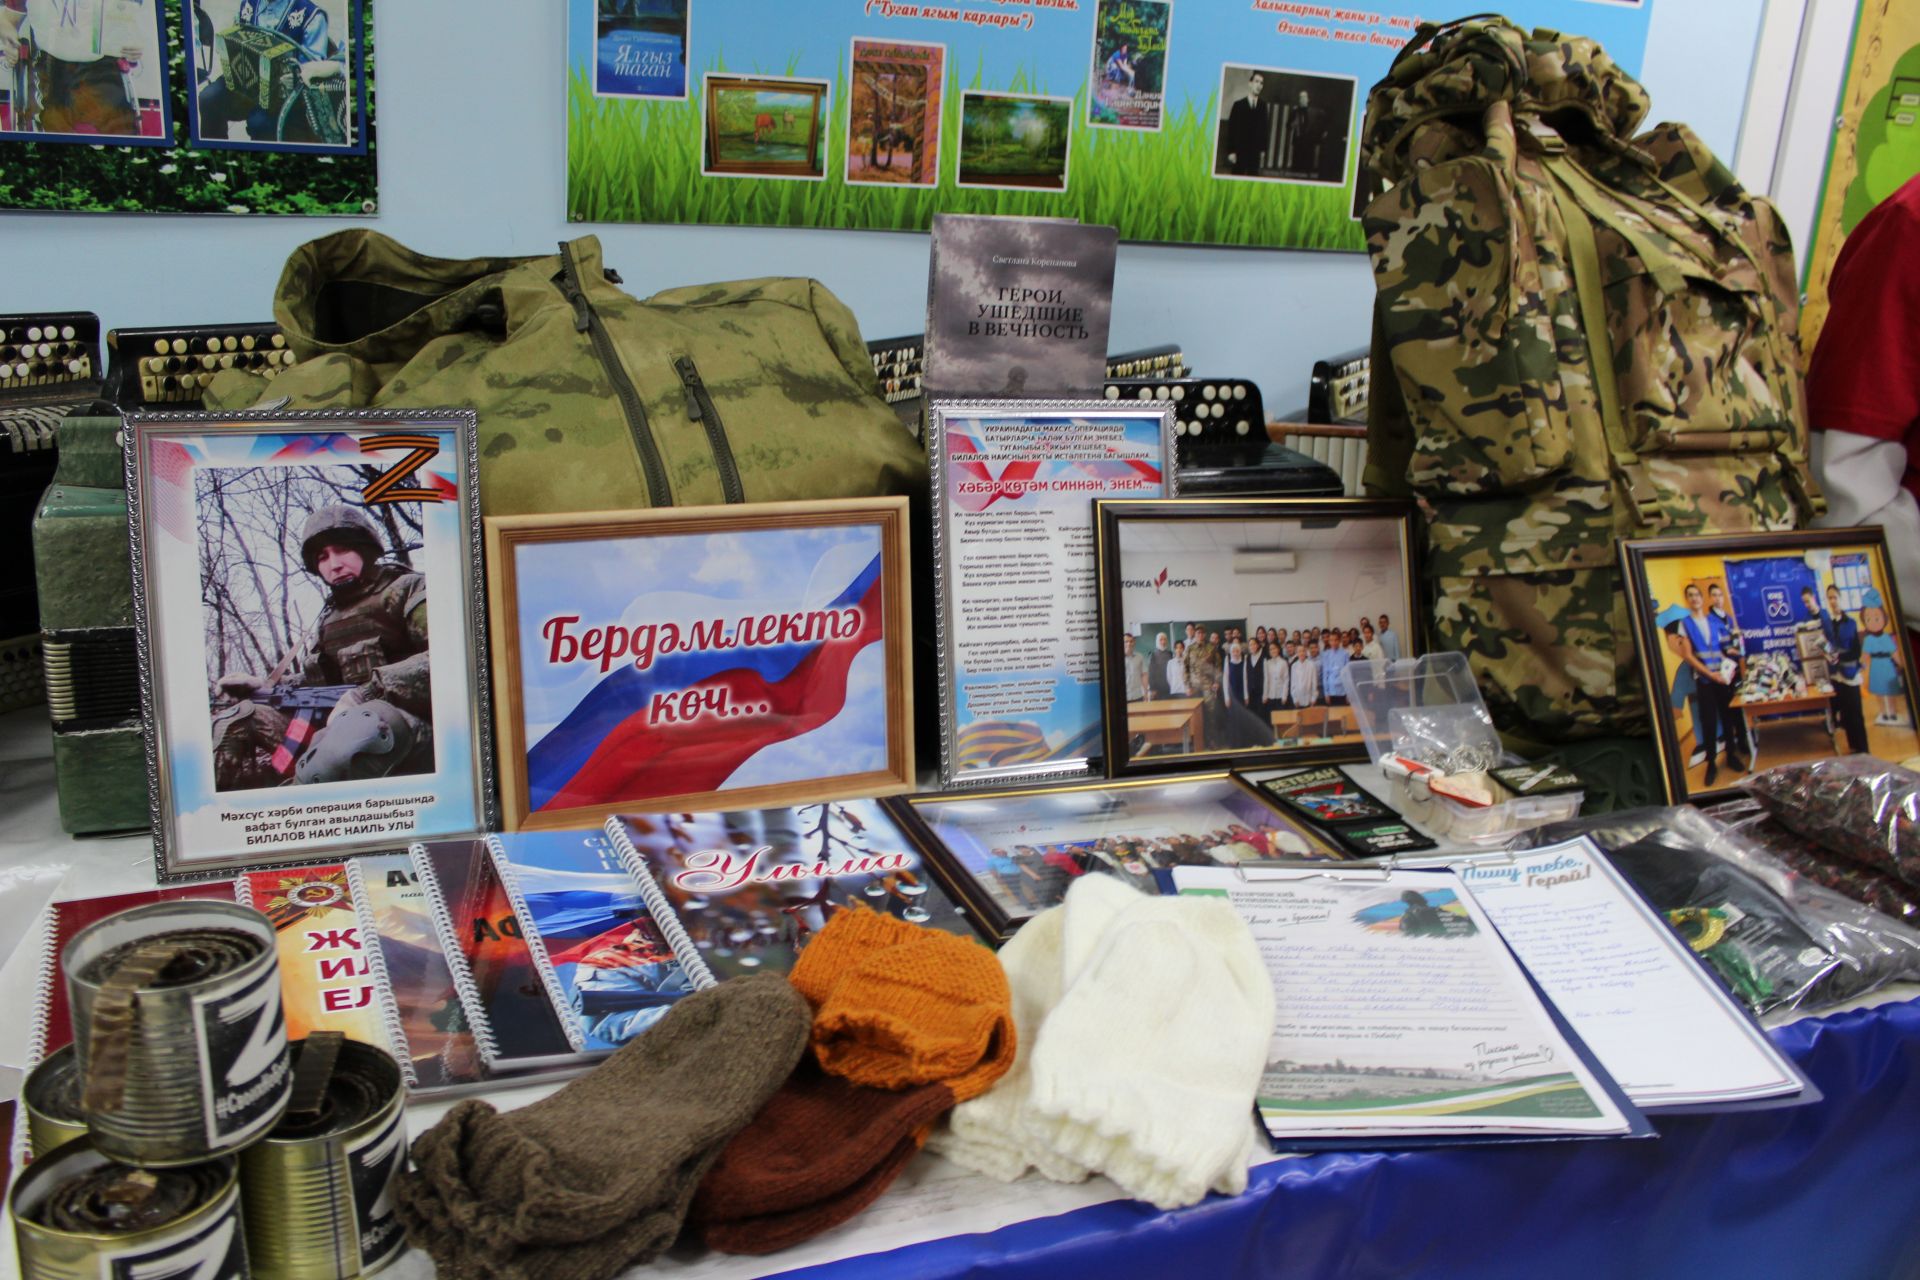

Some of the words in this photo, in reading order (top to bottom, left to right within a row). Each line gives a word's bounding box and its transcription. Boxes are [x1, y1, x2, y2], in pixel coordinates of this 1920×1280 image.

[921, 8, 959, 20] ягым
[614, 44, 673, 65] Ялгыз
[614, 63, 672, 78] таган
[992, 255, 1029, 266] Светлана
[998, 287, 1066, 305] ГЕРОИ,
[977, 304, 1084, 322] УШЕДШИЕ
[968, 321, 980, 336] В
[984, 322, 1089, 340] ВЕЧНОСТЬ
[1043, 425, 1072, 433] МАХСУС
[985, 434, 1035, 442] БАТЫРЛАРЧА
[1065, 434, 1093, 442] БУЛГАН
[951, 453, 989, 461] БИЛАЛОВ
[958, 481, 1001, 494] ХӘБӘР
[1004, 480, 1048, 493] КӨТӘМ
[1051, 479, 1106, 492] СИННӘН,
[1110, 479, 1153, 490] ЭНЕМ...
[1168, 579, 1198, 587] РОСТА
[543, 607, 862, 673] Бердәмлектә
[649, 687, 769, 724] көч...
[267, 807, 303, 821] хәрби
[306, 802, 362, 814] операция
[365, 794, 435, 809] барышында
[245, 821, 281, 833] вафат
[284, 816, 326, 829] булган
[329, 809, 415, 825] авылдашыбыз
[246, 831, 305, 845] БИЛАЛОВ
[309, 827, 341, 839] НАИС
[344, 824, 385, 836] НАИЛЬ
[388, 821, 415, 832] УЛЫ
[1462, 866, 1521, 882] Пишу
